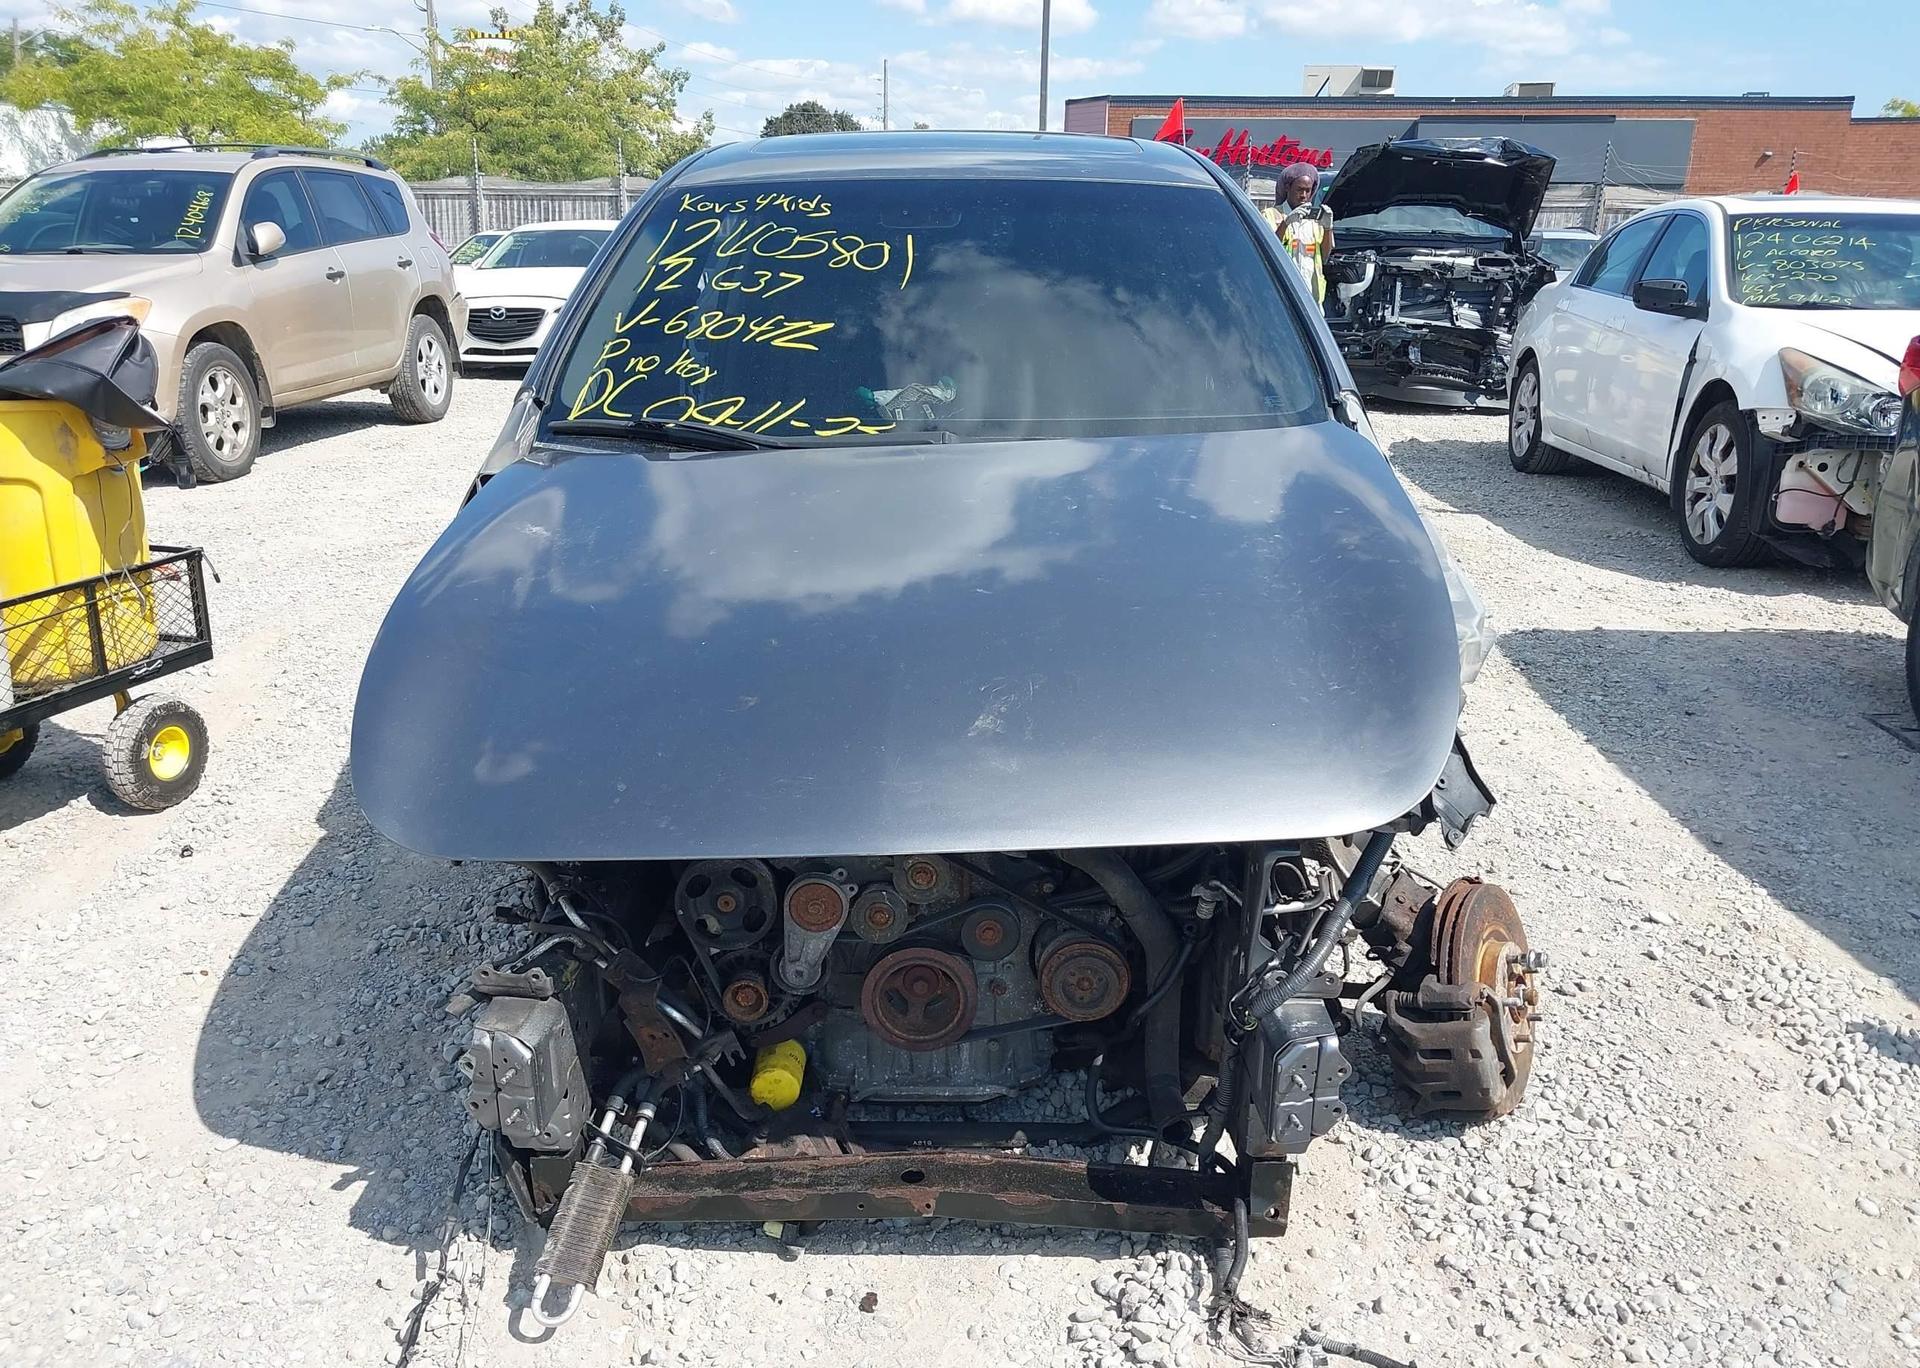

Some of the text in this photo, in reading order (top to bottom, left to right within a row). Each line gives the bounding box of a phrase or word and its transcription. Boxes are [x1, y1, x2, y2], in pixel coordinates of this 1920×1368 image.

[1214, 127, 1335, 168] Hortons
[1733, 217, 1842, 231] PERSONAL
[711, 265, 805, 298] G37
